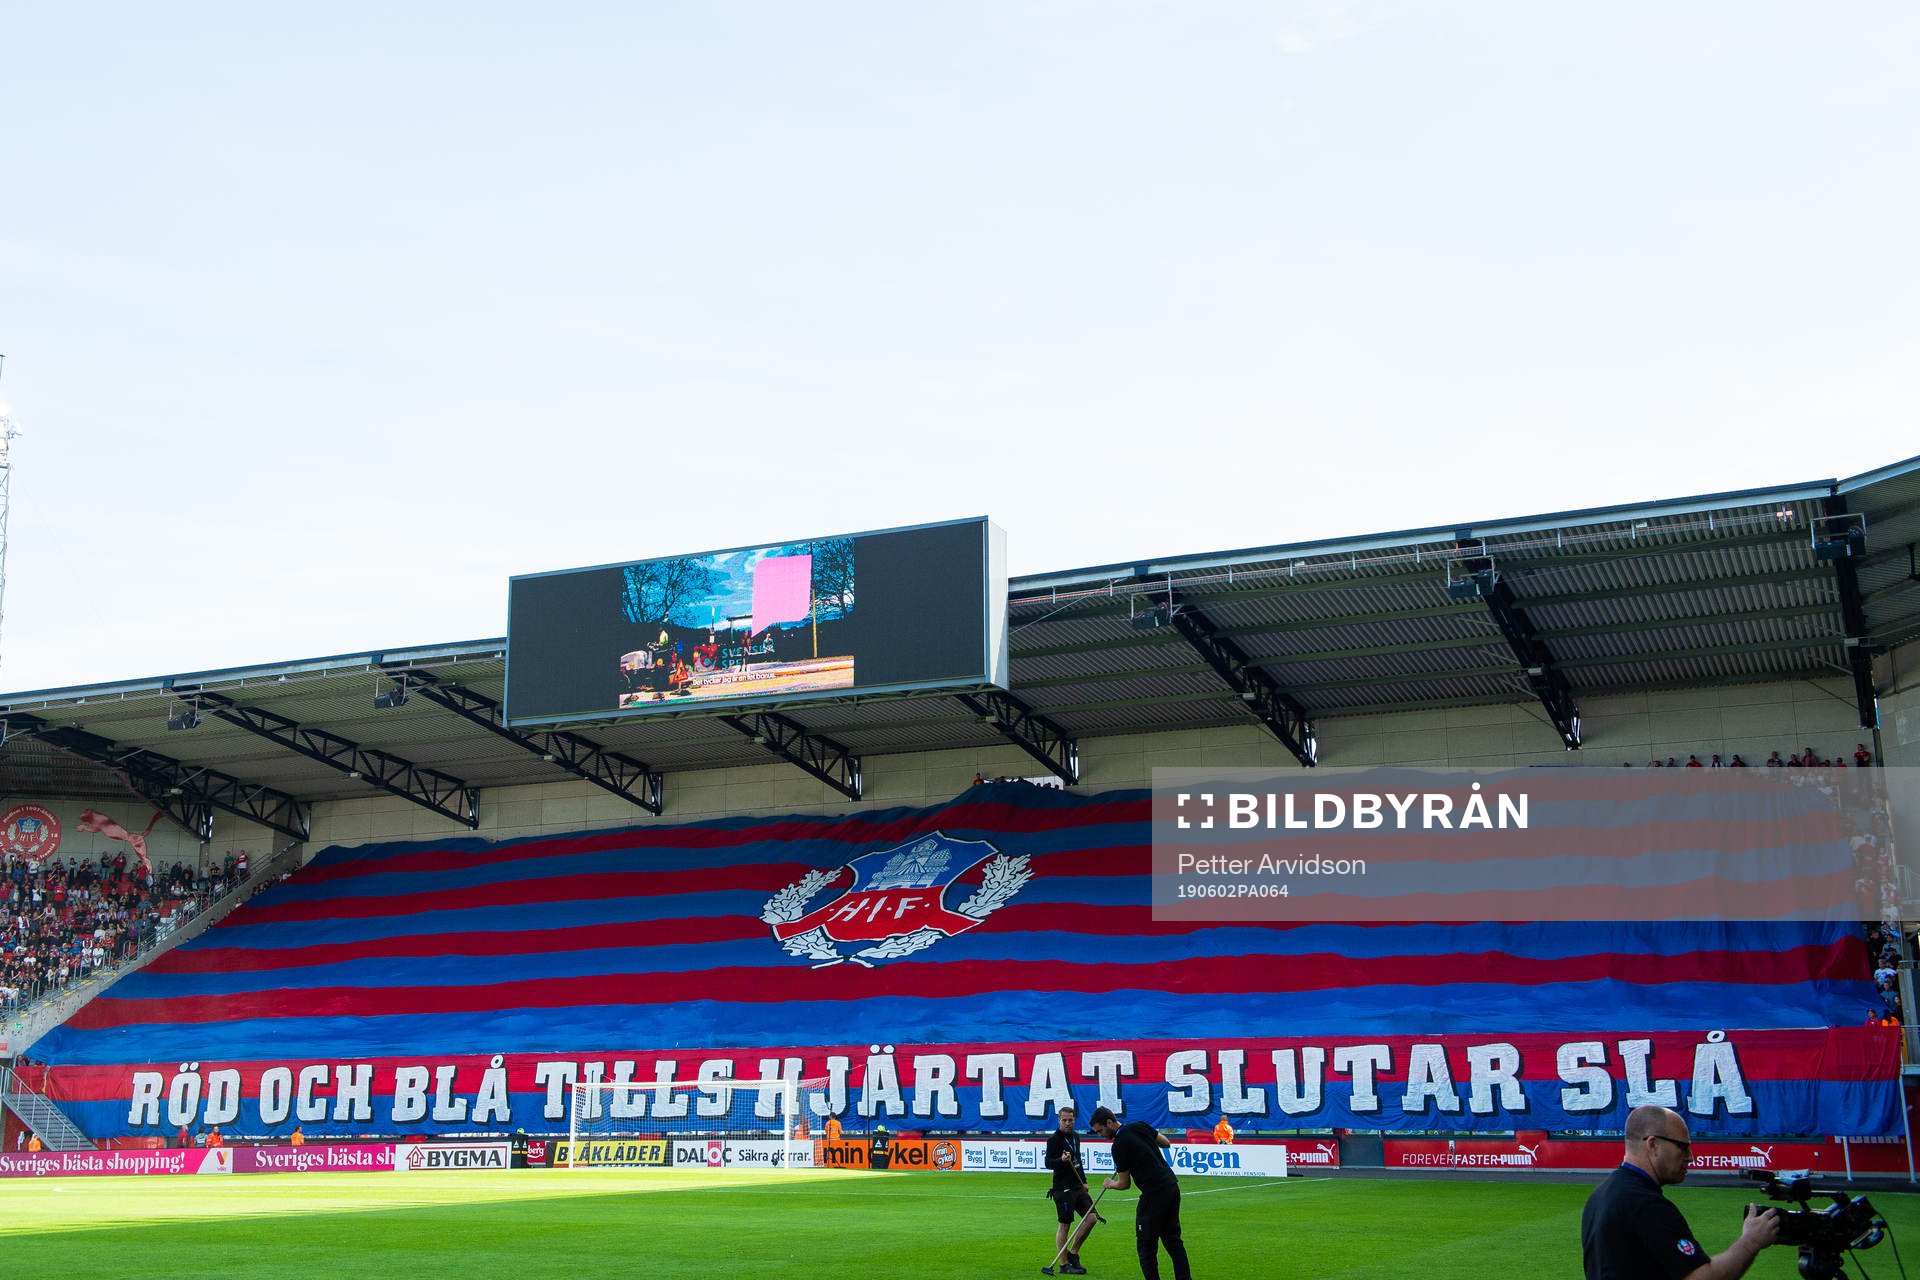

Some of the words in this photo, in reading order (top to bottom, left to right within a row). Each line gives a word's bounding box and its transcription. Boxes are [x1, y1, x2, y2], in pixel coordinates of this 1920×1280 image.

[127, 1062, 240, 1126] RÖD
[259, 1064, 373, 1125] OCH
[391, 1055, 511, 1123] BLÅ
[534, 1058, 734, 1119] TILLS
[753, 1044, 1134, 1119] HJÄRTAT
[1164, 1043, 1527, 1116] SLUTAR
[1556, 1031, 1753, 1115] SLÅ
[557, 1142, 661, 1162] BÅKLÄDER
[677, 1146, 732, 1165] DALOC
[738, 1149, 769, 1161] Säkra
[823, 1142, 863, 1164] min
[868, 1142, 929, 1168] ykel
[965, 1148, 983, 1156] Paras
[989, 1148, 1008, 1156] Paras
[1015, 1148, 1034, 1157] Paras
[0, 1155, 60, 1175] Sveriges
[63, 1153, 103, 1171] bästa
[106, 1151, 185, 1174] shopping!
[255, 1149, 324, 1171] Sveriges
[327, 1148, 372, 1167] bästa
[426, 1150, 502, 1167] BYGMA
[967, 1155, 983, 1164] Bygg
[992, 1155, 1008, 1164] Bygg
[1017, 1155, 1034, 1164] Bygg
[1096, 1157, 1112, 1166] Bygg
[1161, 1146, 1240, 1174] Vågen
[1687, 1156, 1728, 1167] ASTER
